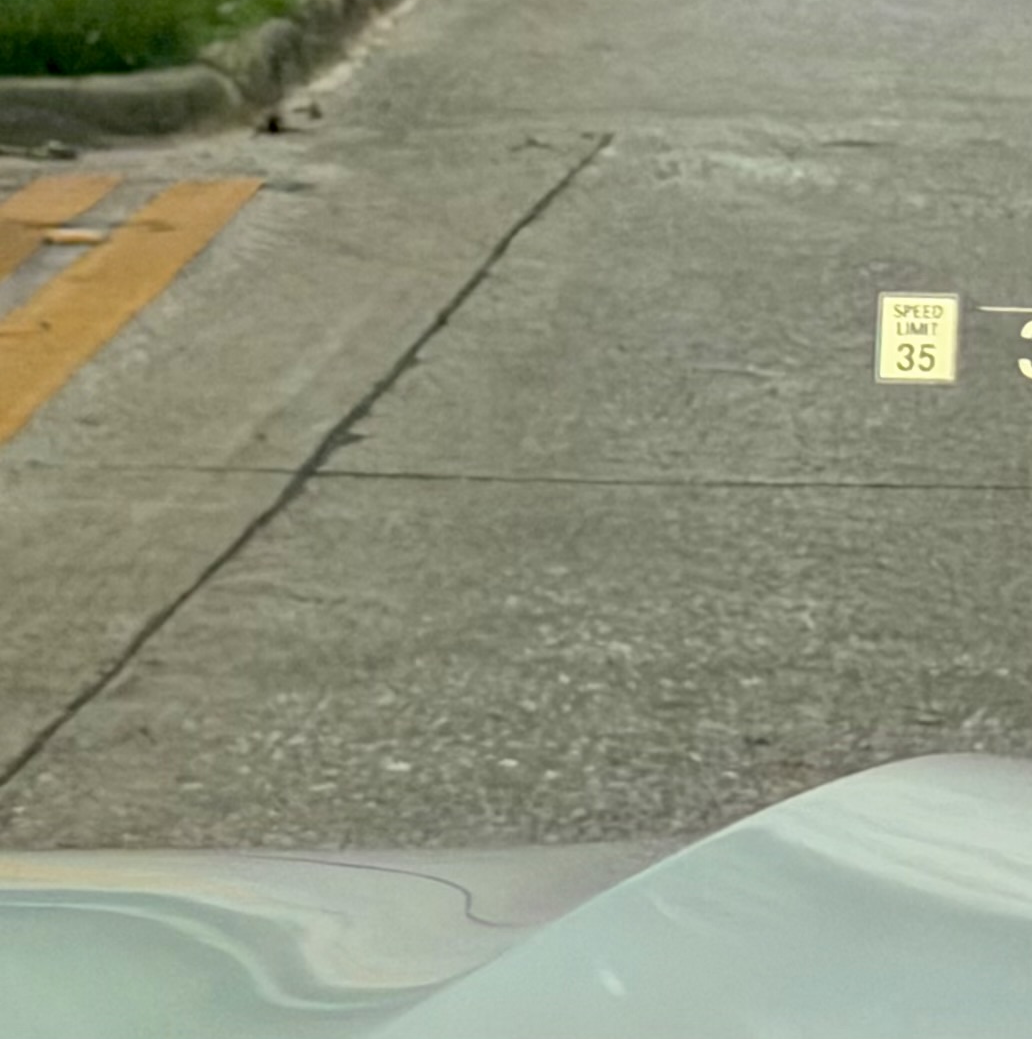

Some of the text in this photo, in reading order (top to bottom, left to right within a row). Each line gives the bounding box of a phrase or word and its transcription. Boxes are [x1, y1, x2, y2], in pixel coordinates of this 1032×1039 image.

[893, 304, 943, 318] SPEED
[896, 323, 938, 336] LIMIT
[897, 343, 935, 371] 35
